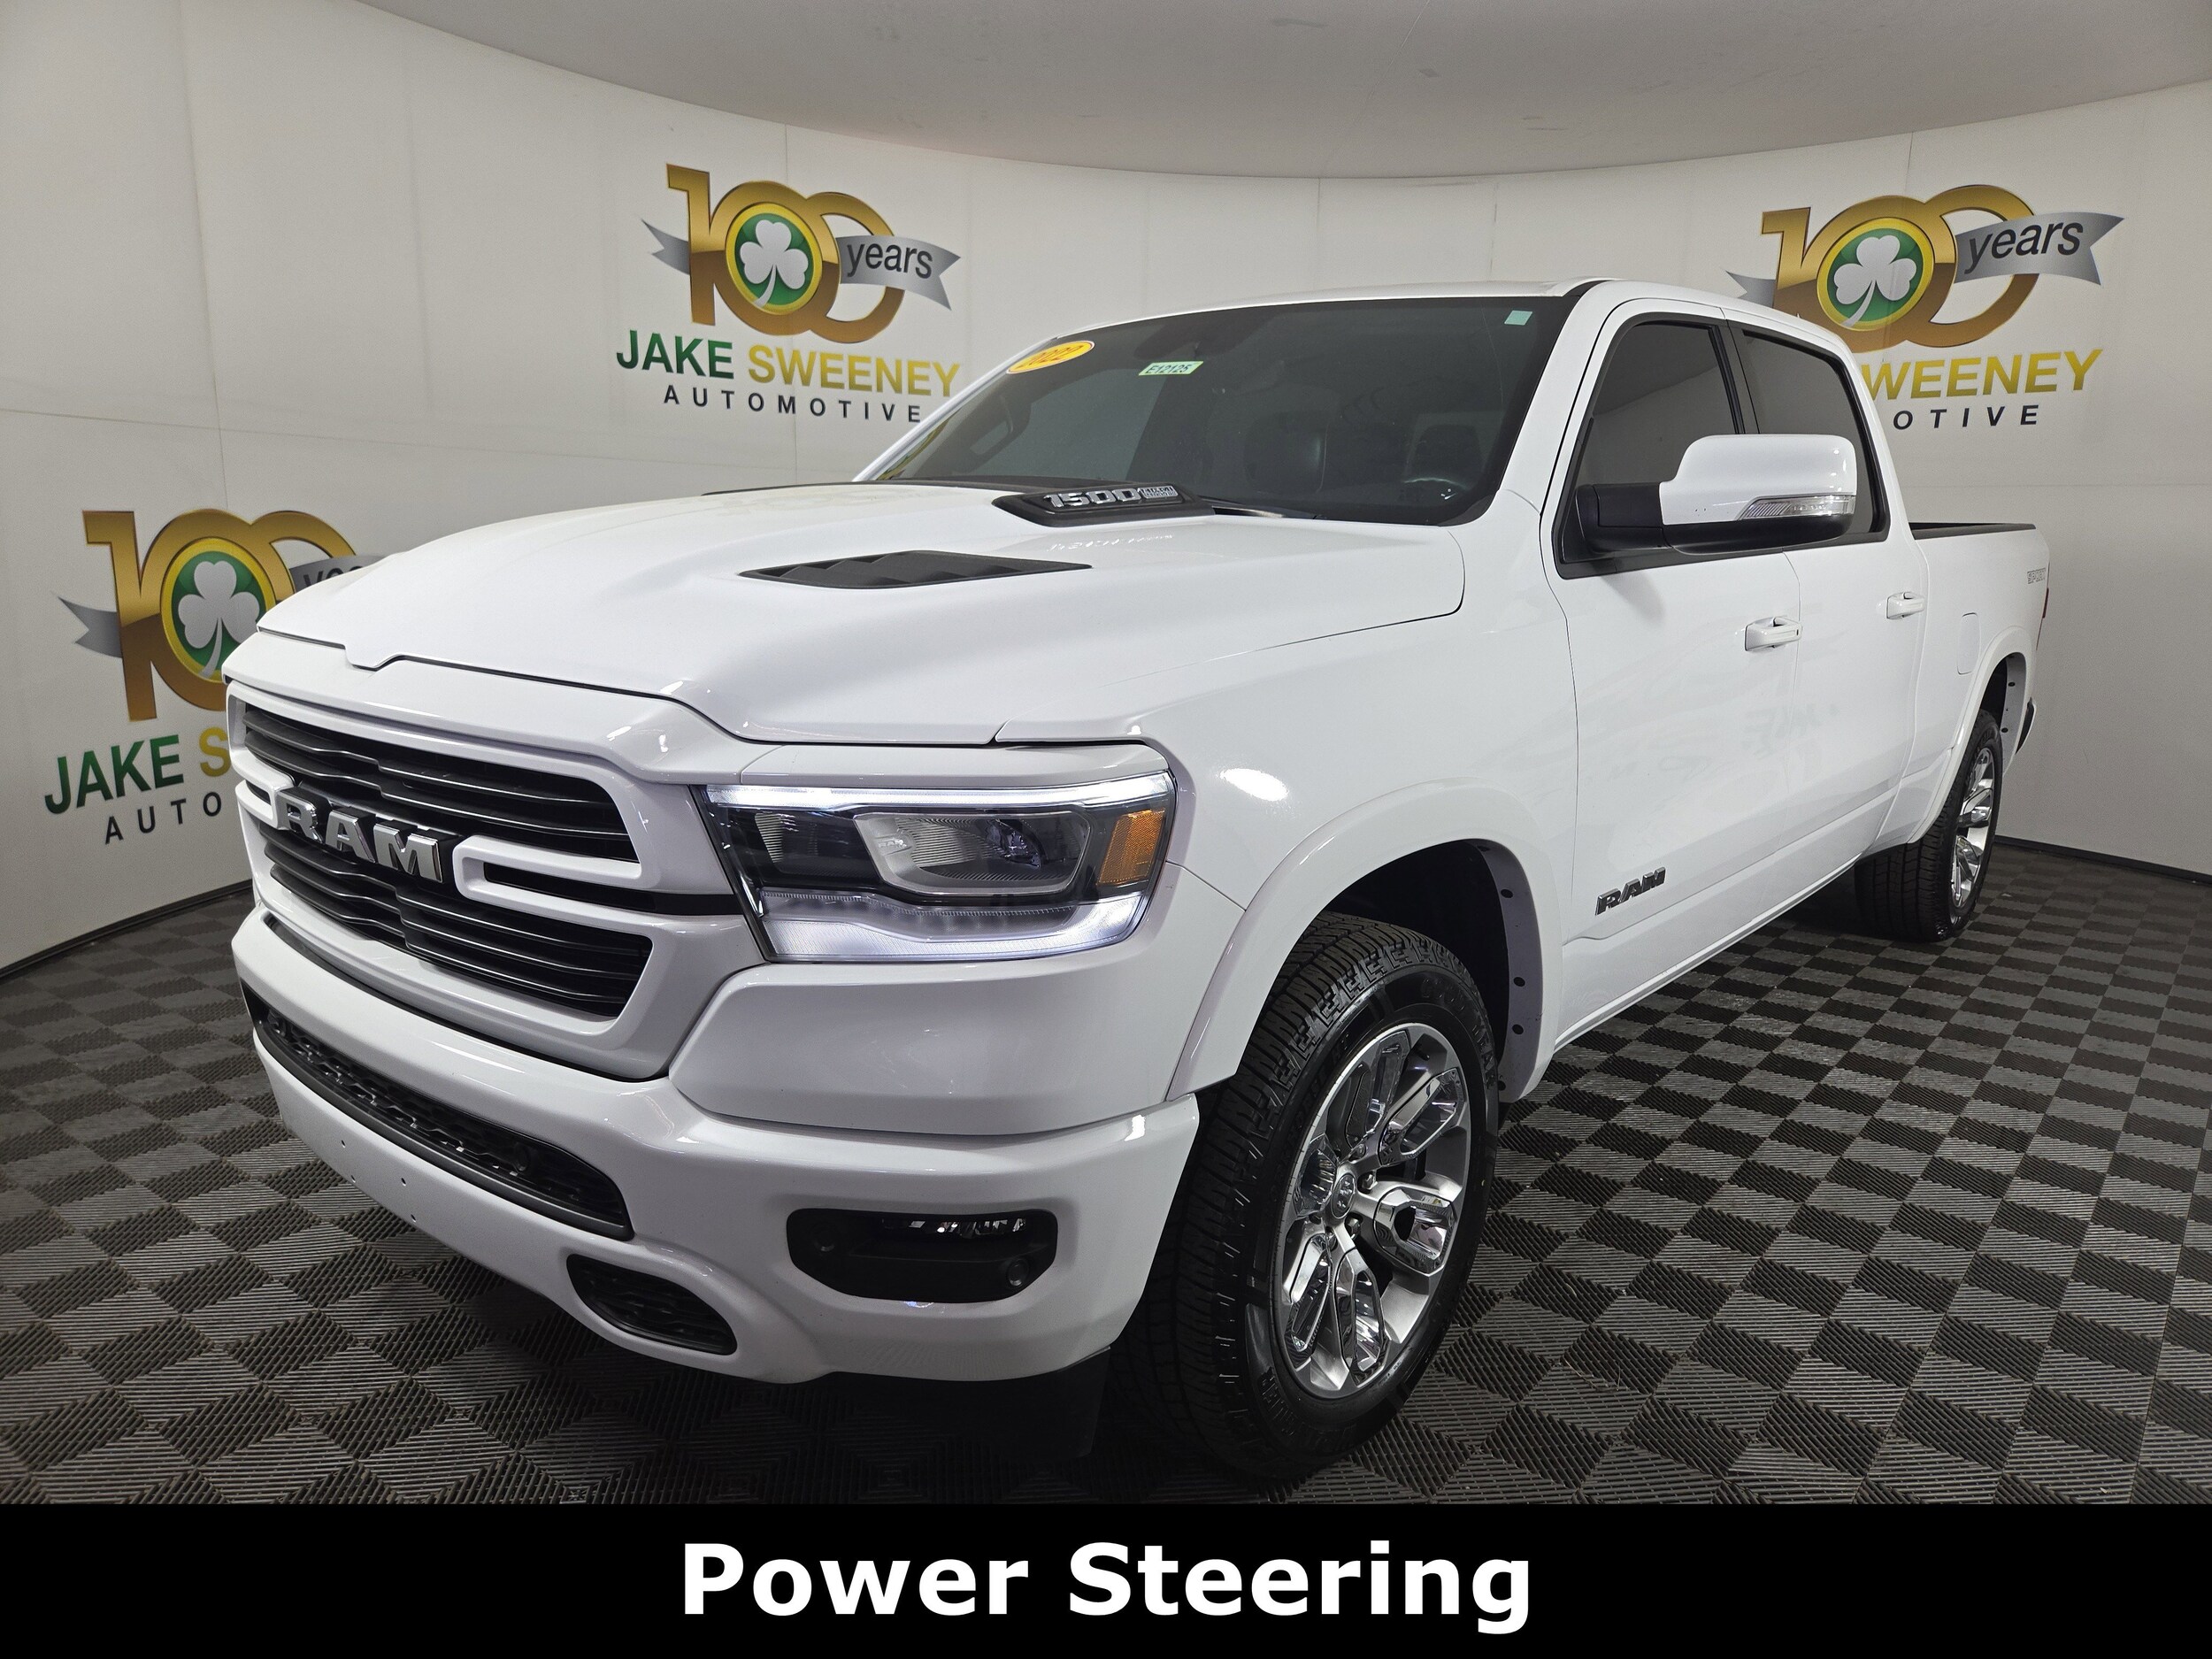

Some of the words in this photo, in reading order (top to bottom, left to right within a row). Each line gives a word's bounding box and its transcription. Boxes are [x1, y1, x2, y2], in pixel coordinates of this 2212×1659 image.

[846, 243, 933, 279] years
[1963, 221, 2084, 274] years
[616, 329, 734, 380] JAKE
[748, 344, 961, 397] SWEENEY
[1145, 364, 1193, 374] E12125
[1861, 349, 2102, 401] WEENEY
[664, 384, 921, 423] AUTOMOTIVE
[1893, 404, 2039, 430] OTIVE
[1043, 488, 1142, 508] 1500
[44, 734, 184, 816] JAKE
[277, 787, 445, 884] RAM
[1594, 866, 1666, 916] RAM
